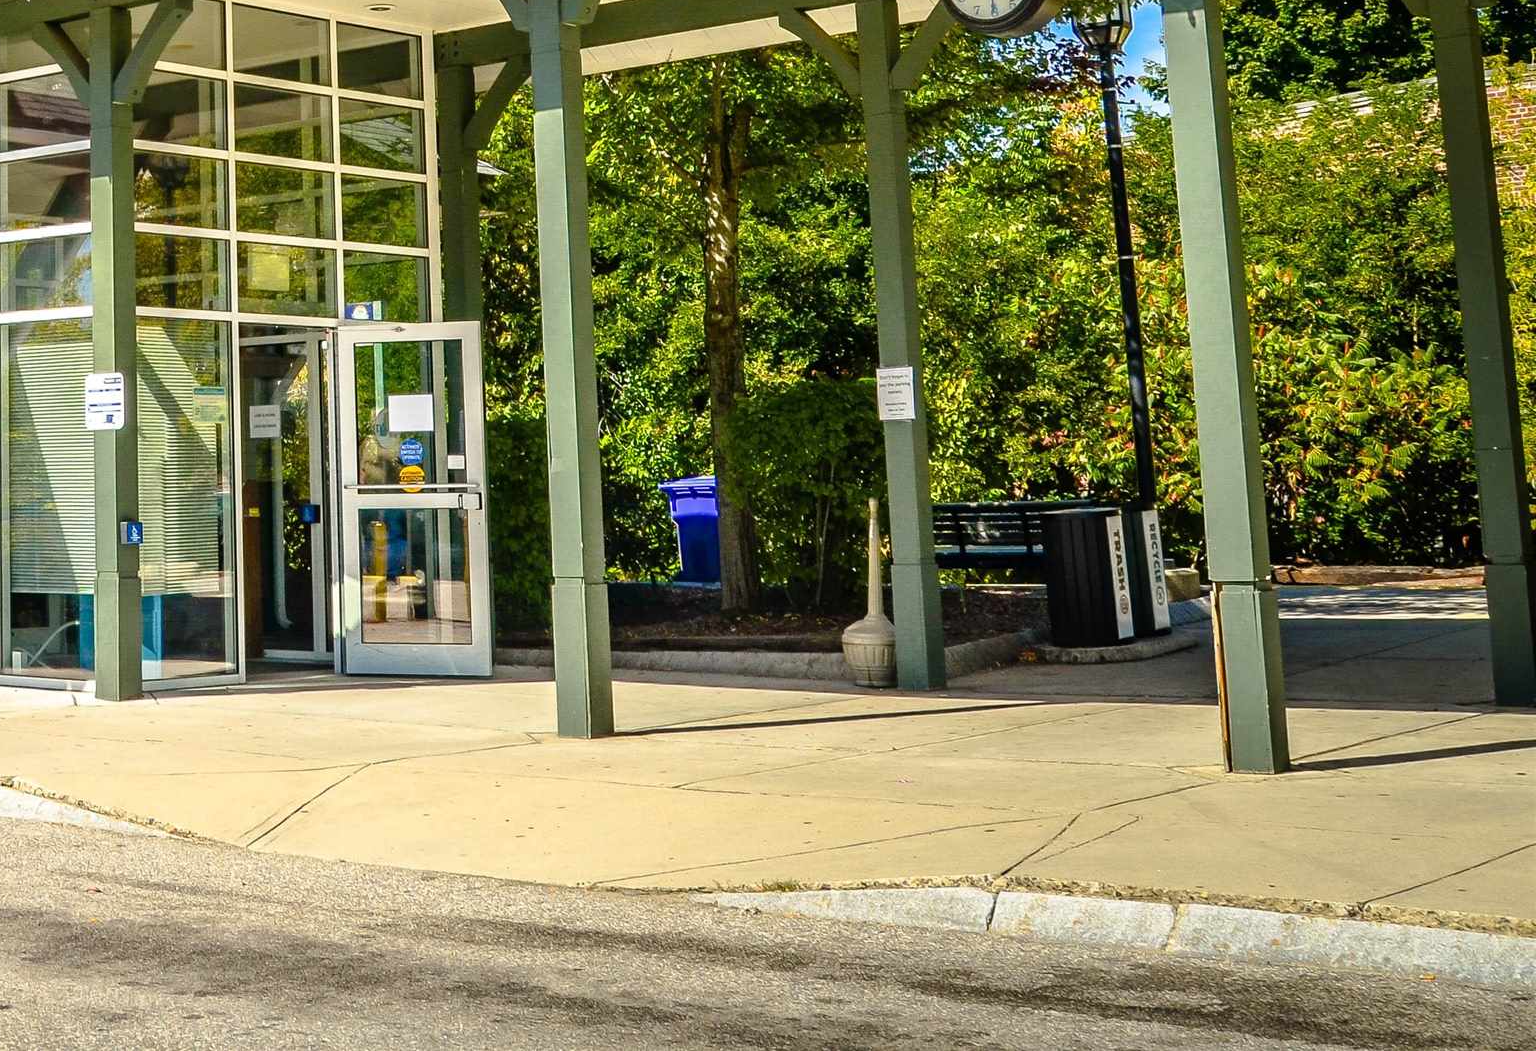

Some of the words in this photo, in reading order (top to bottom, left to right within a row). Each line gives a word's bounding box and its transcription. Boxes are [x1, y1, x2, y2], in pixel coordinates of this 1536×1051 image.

[974, 6, 980, 15] 7
[1113, 529, 1126, 591] TRASH
[1149, 523, 1162, 583] RECYCLE
